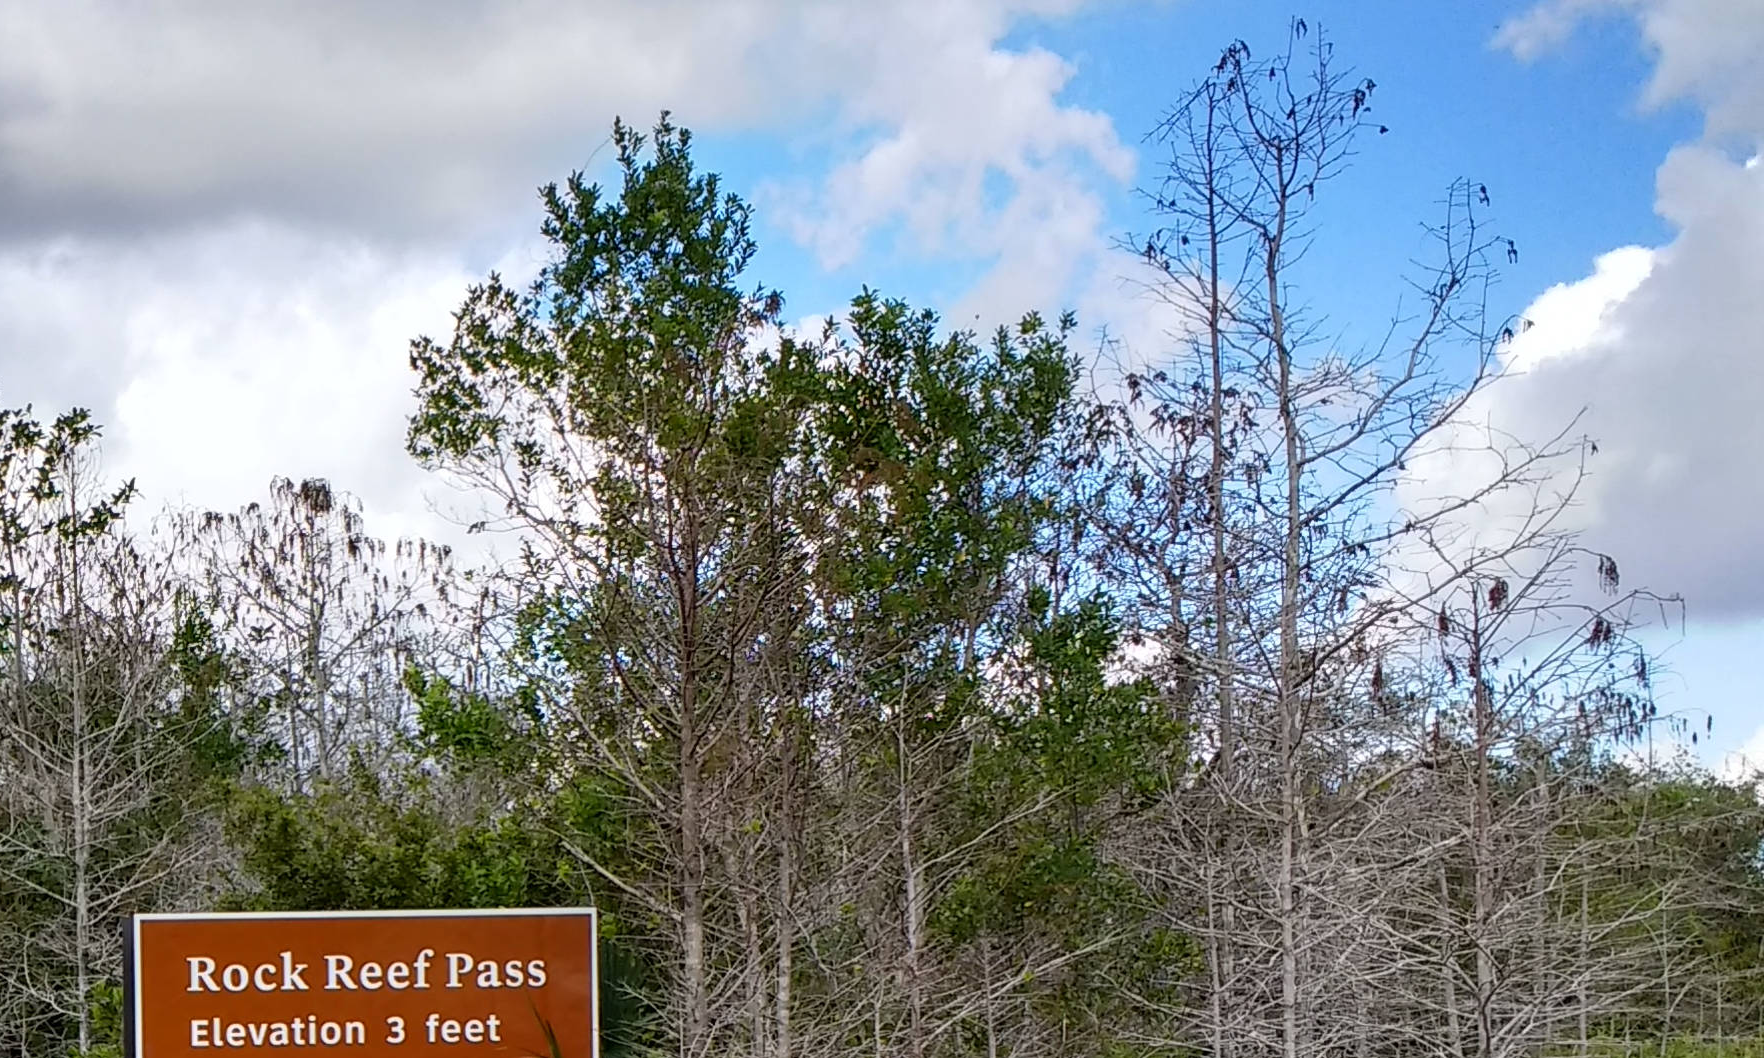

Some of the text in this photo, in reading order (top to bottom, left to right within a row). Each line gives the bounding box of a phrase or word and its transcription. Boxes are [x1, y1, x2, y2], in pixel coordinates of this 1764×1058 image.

[186, 949, 547, 992] Rock Reef Pass
[190, 1014, 501, 1047] Elevation 3 feet
